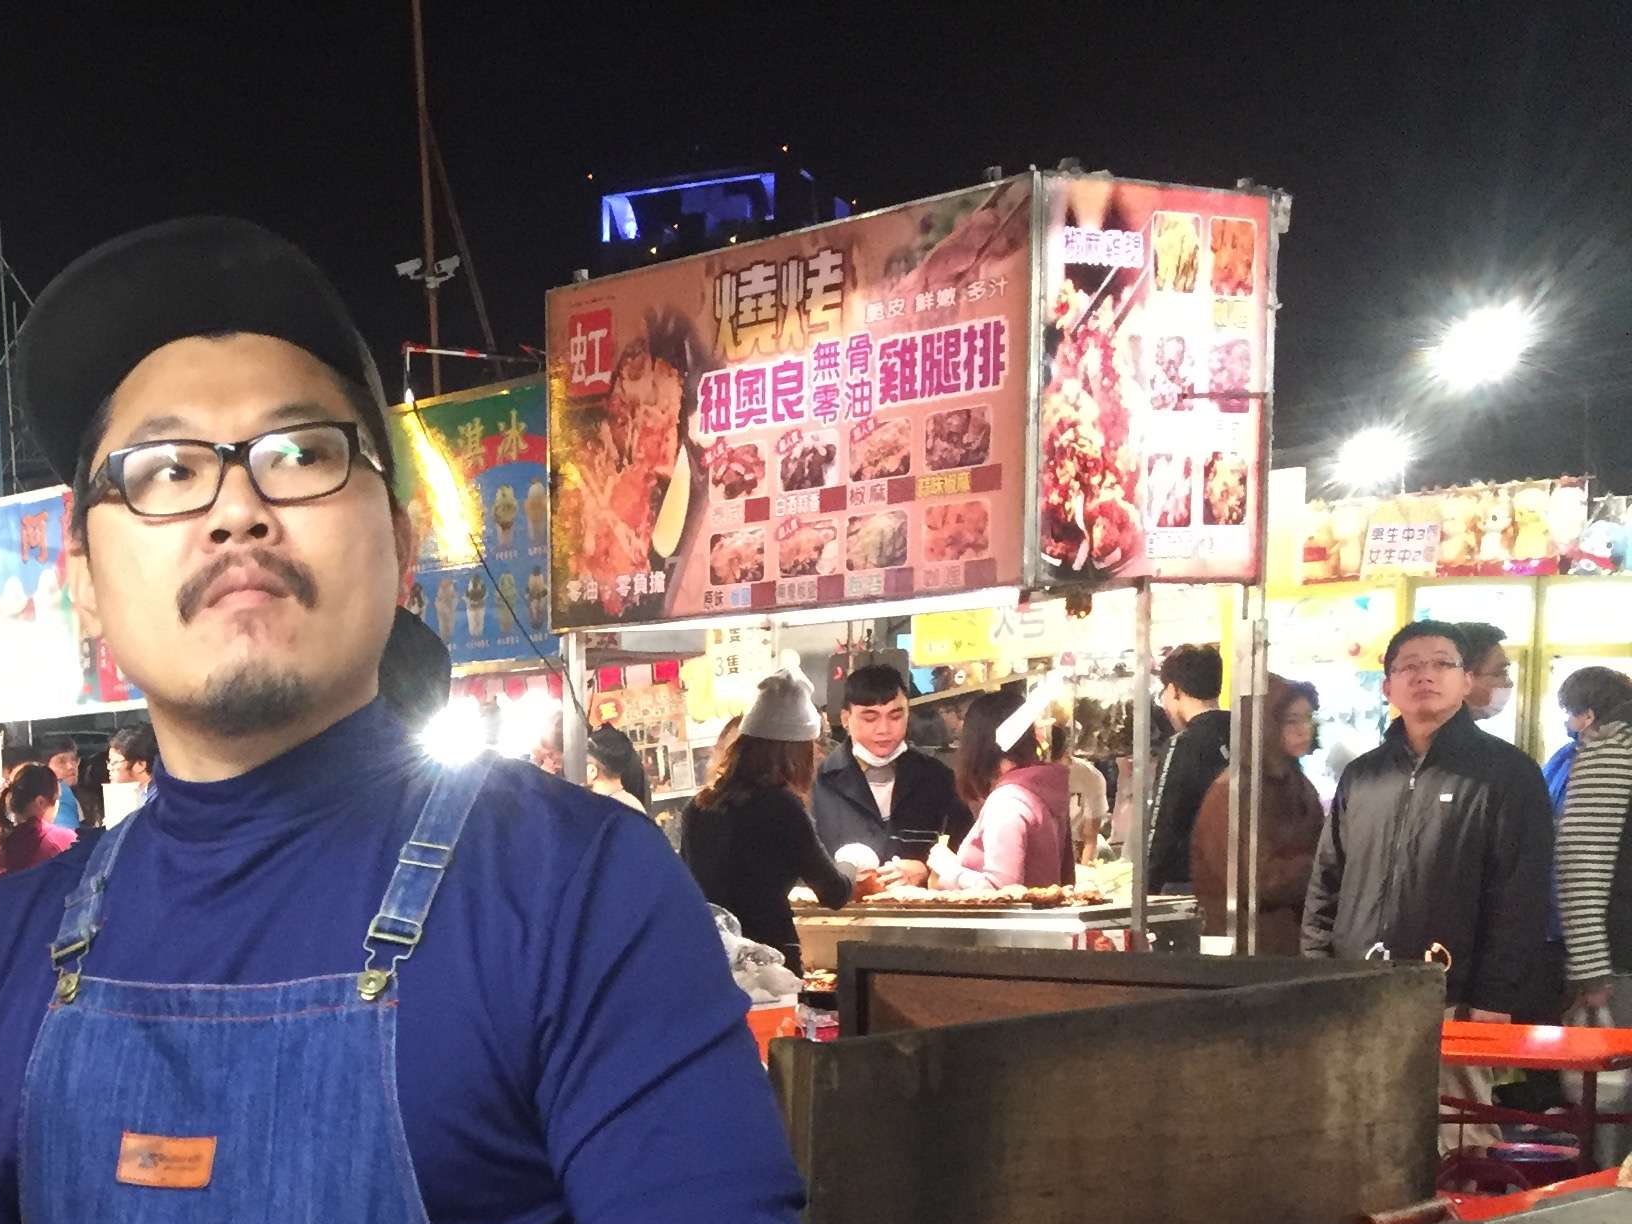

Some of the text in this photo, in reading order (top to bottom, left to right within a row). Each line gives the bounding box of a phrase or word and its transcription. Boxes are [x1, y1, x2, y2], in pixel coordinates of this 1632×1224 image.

[714, 248, 844, 361] 燒烤
[968, 277, 1008, 302] 多汁
[570, 322, 613, 386] 虹
[813, 333, 873, 384] 無骨
[879, 320, 1006, 405] 雞腿排
[700, 359, 805, 435] 紐奧良
[813, 378, 873, 425] 零油
